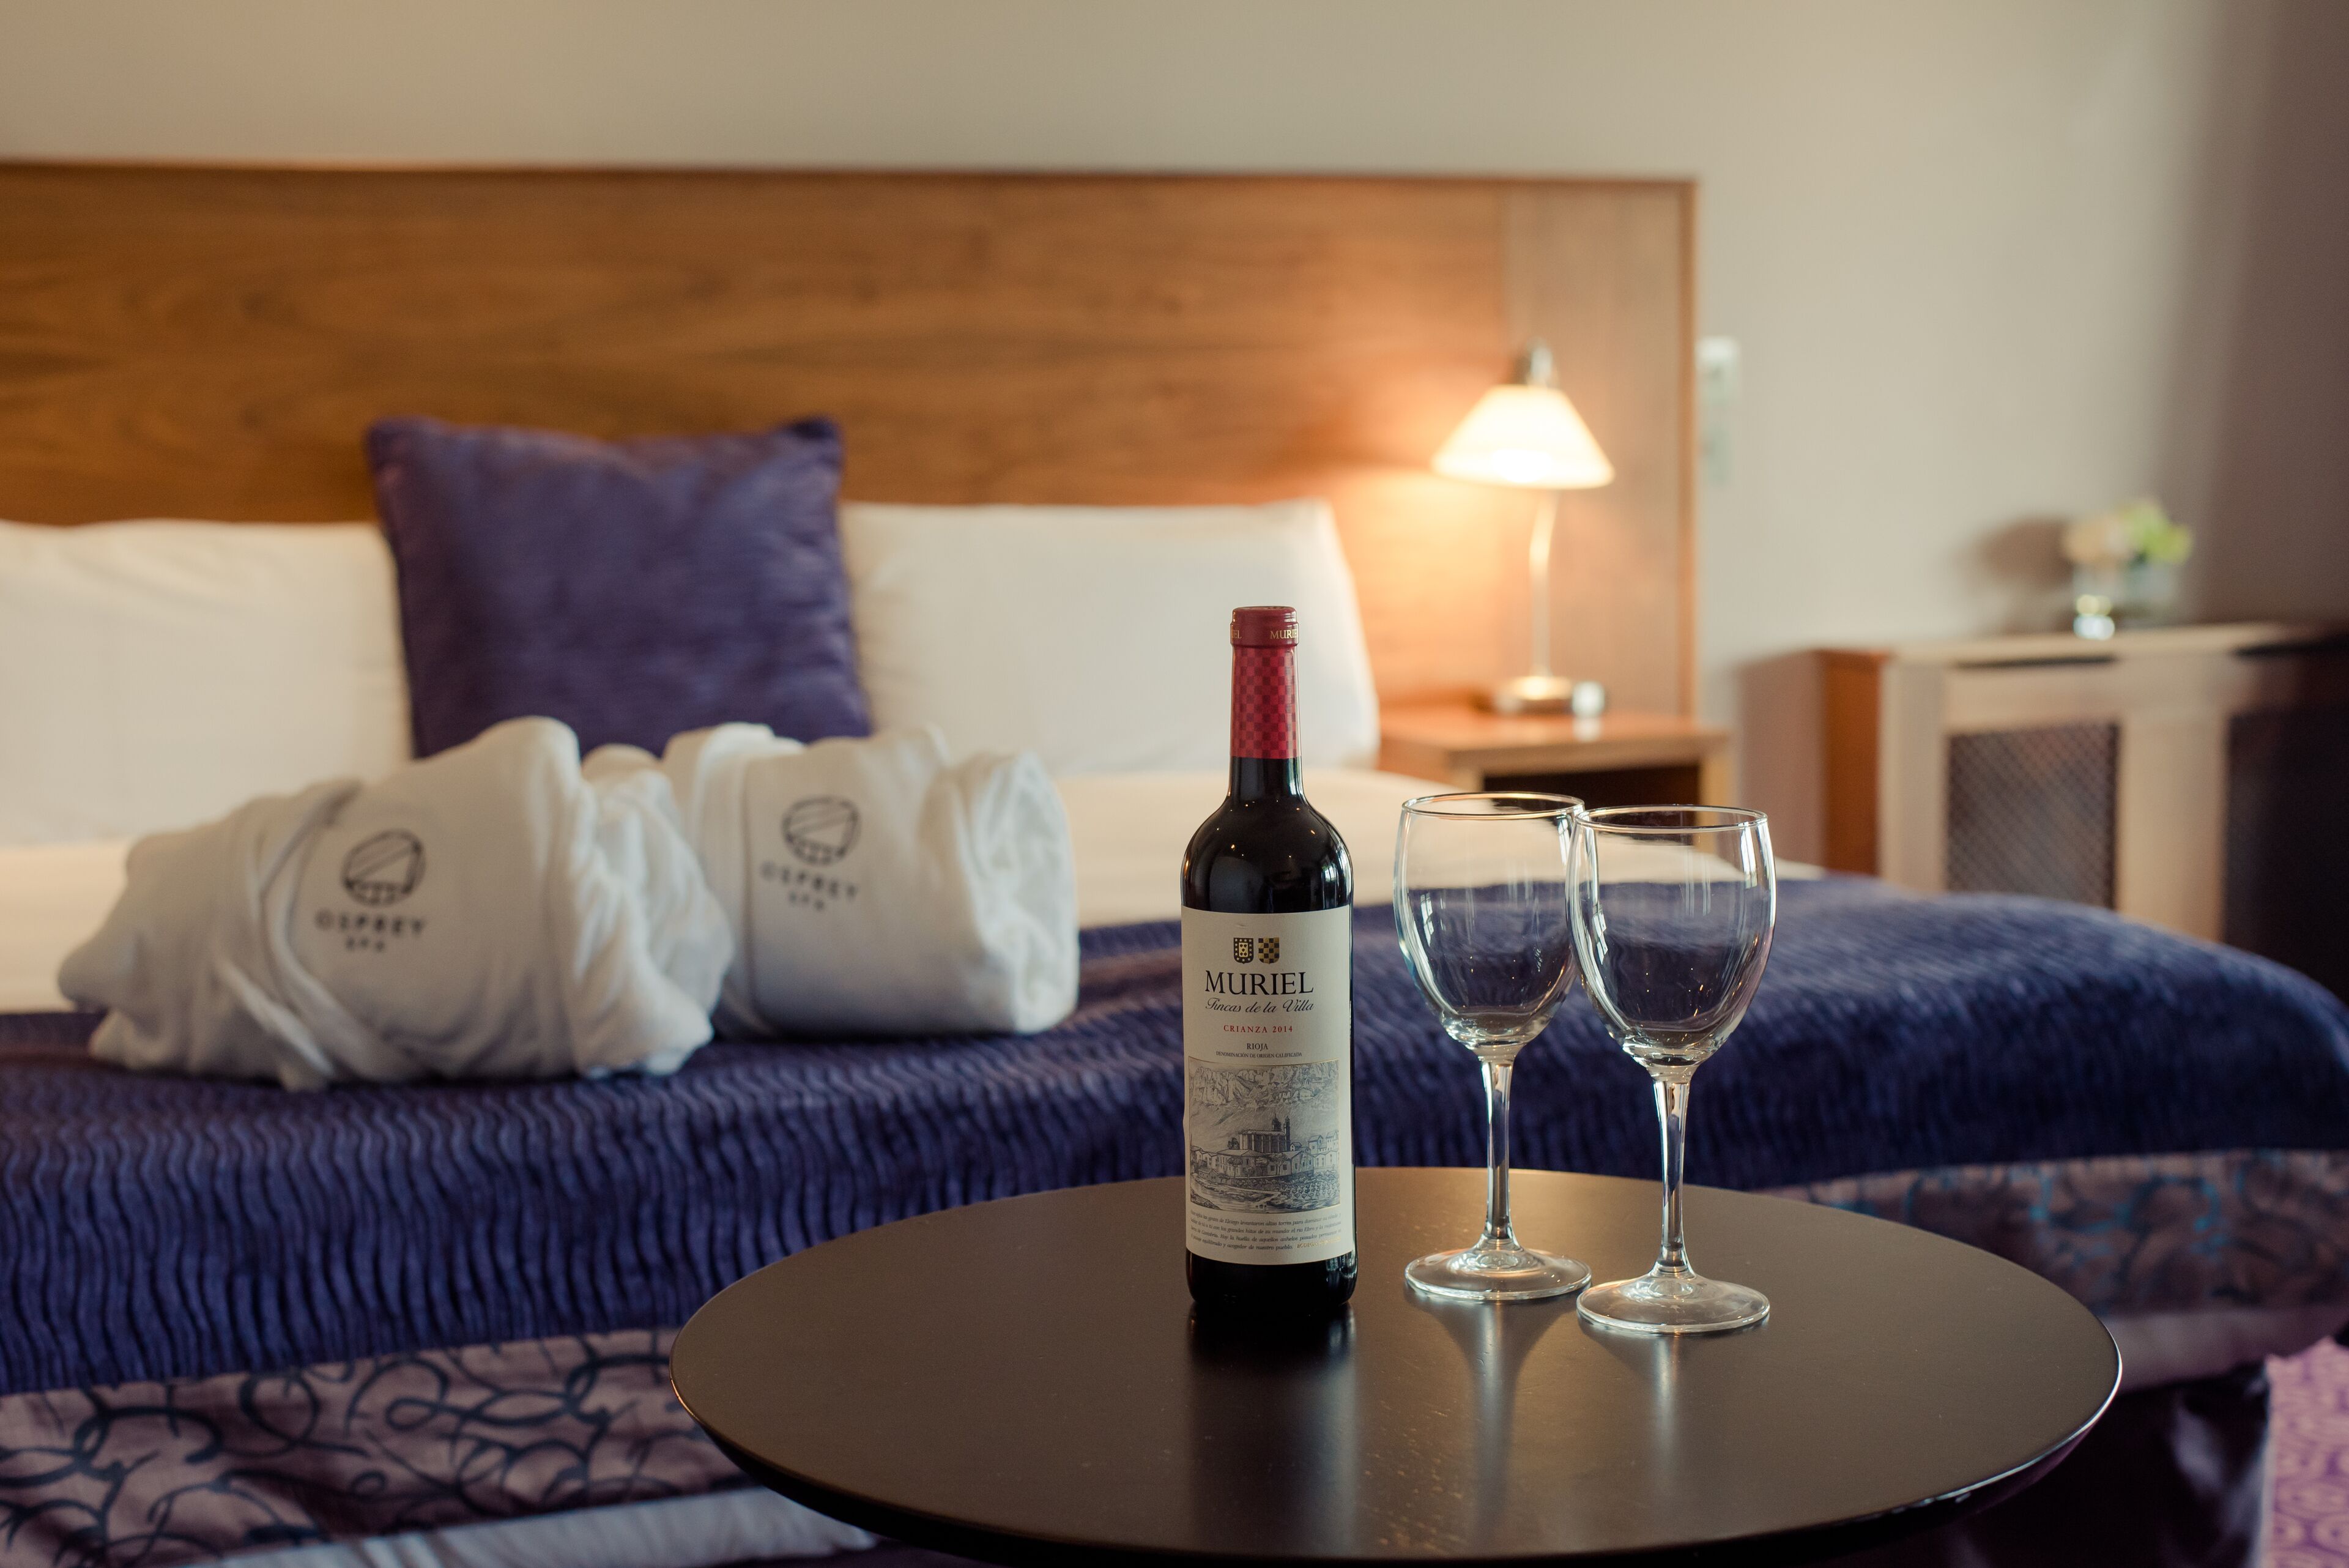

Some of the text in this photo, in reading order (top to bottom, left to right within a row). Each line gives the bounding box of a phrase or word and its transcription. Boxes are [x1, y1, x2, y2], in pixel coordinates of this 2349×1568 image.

[1231, 630, 1242, 639] IEL
[1270, 629, 1297, 639] MURIE
[760, 861, 859, 902] OSPREY
[314, 908, 426, 938] OSPREY
[1204, 970, 1314, 995] MURIEL
[1205, 997, 1314, 1013] Fincas de la Villa
[1223, 1025, 1267, 1033] CRIANZA
[1247, 1042, 1268, 1051] RIOJA
